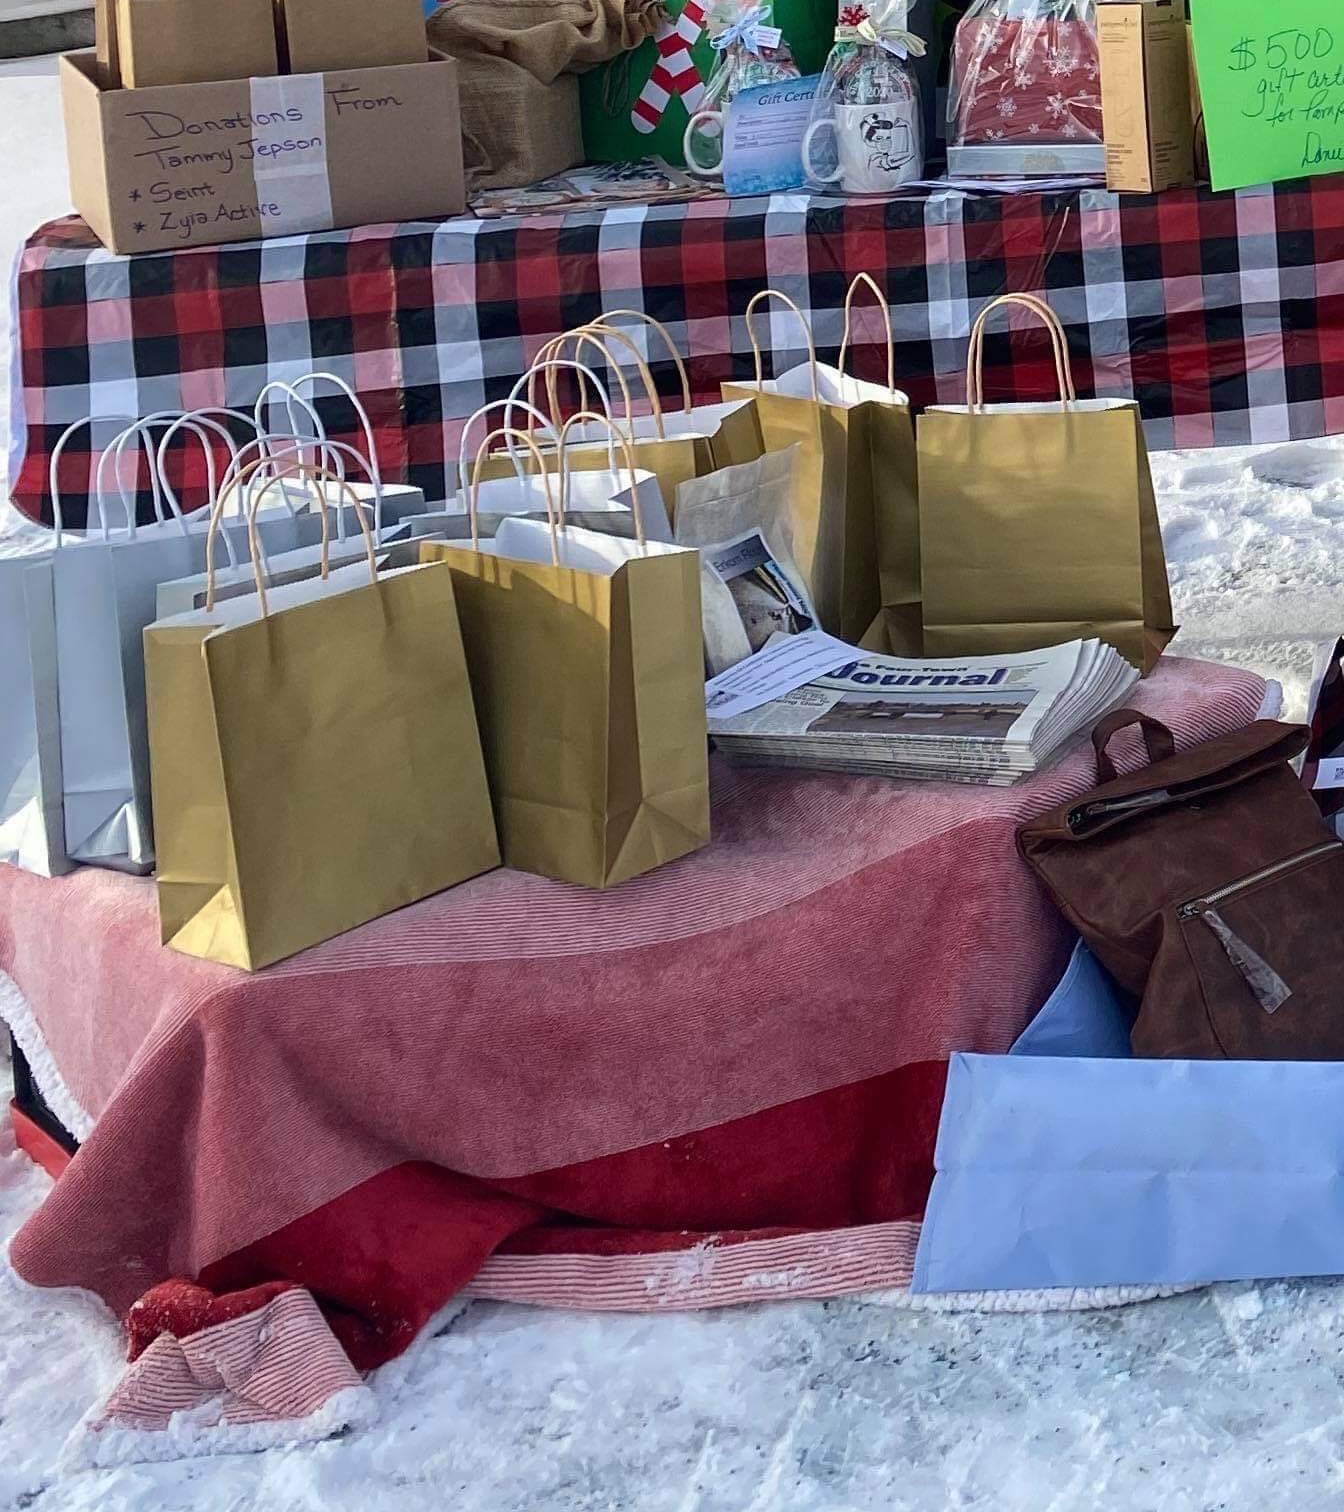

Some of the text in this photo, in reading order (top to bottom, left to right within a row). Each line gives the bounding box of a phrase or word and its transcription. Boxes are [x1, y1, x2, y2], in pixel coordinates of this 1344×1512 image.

[758, 92, 783, 106] Gift
[126, 87, 403, 141] Donations From
[134, 137, 323, 175] Tammy Jepson
[215, 202, 282, 222] Active
[827, 661, 1009, 686] Journal
